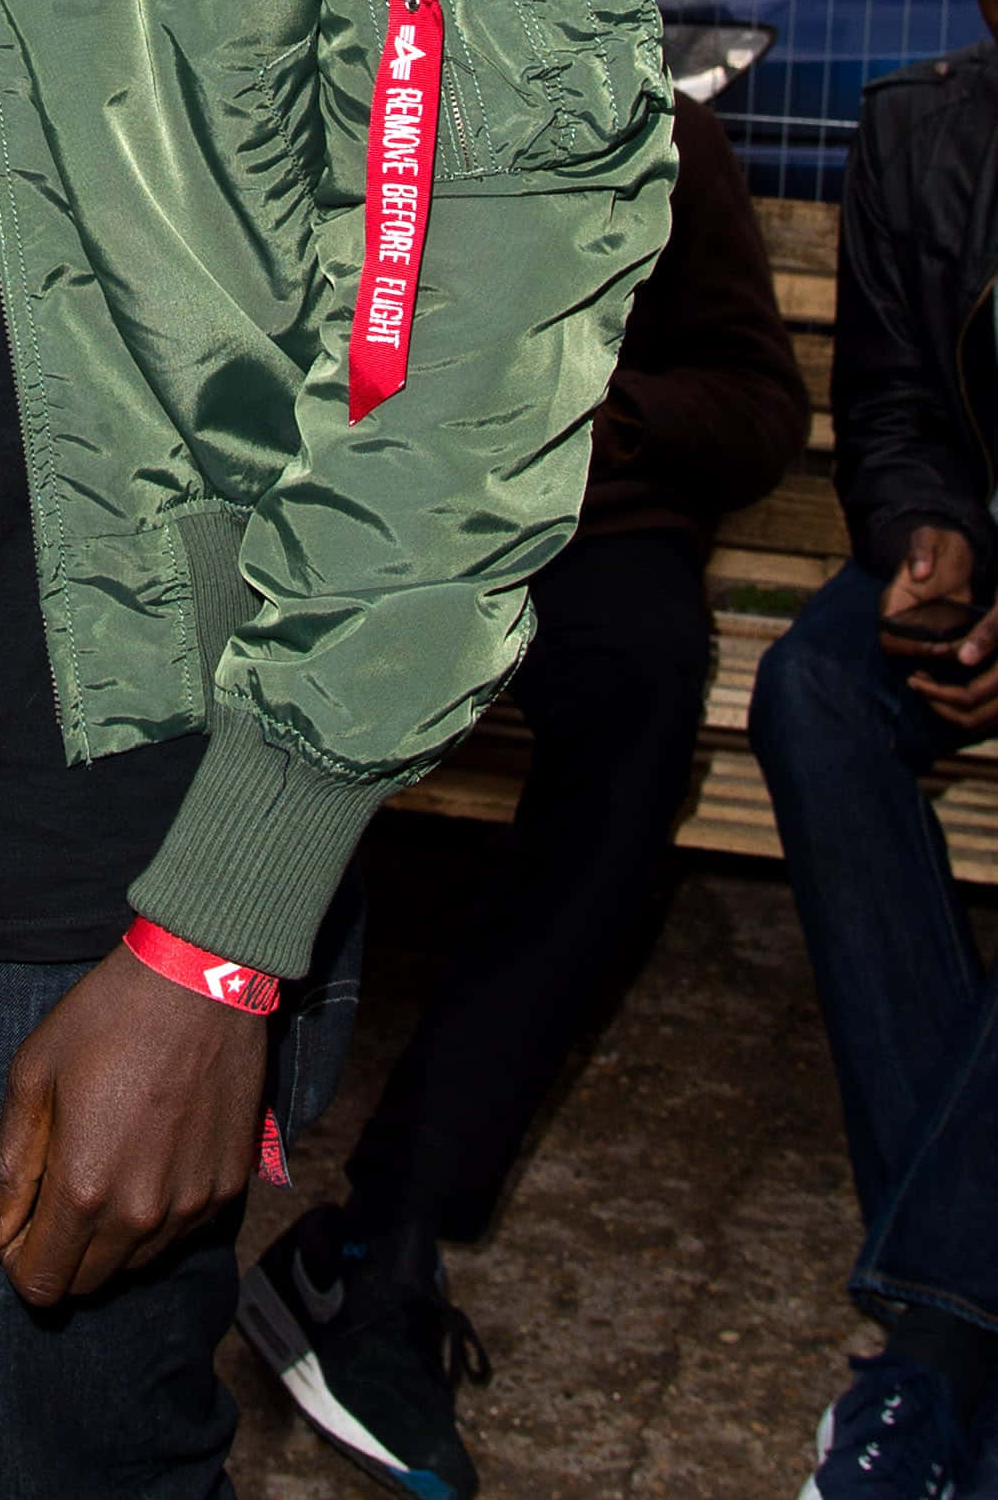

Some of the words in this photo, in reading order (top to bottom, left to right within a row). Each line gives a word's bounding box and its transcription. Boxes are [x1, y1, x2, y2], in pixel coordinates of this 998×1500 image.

[381, 87, 424, 177] REMOVE
[378, 182, 418, 266] BEFORE
[365, 275, 408, 350] FLIGHT
